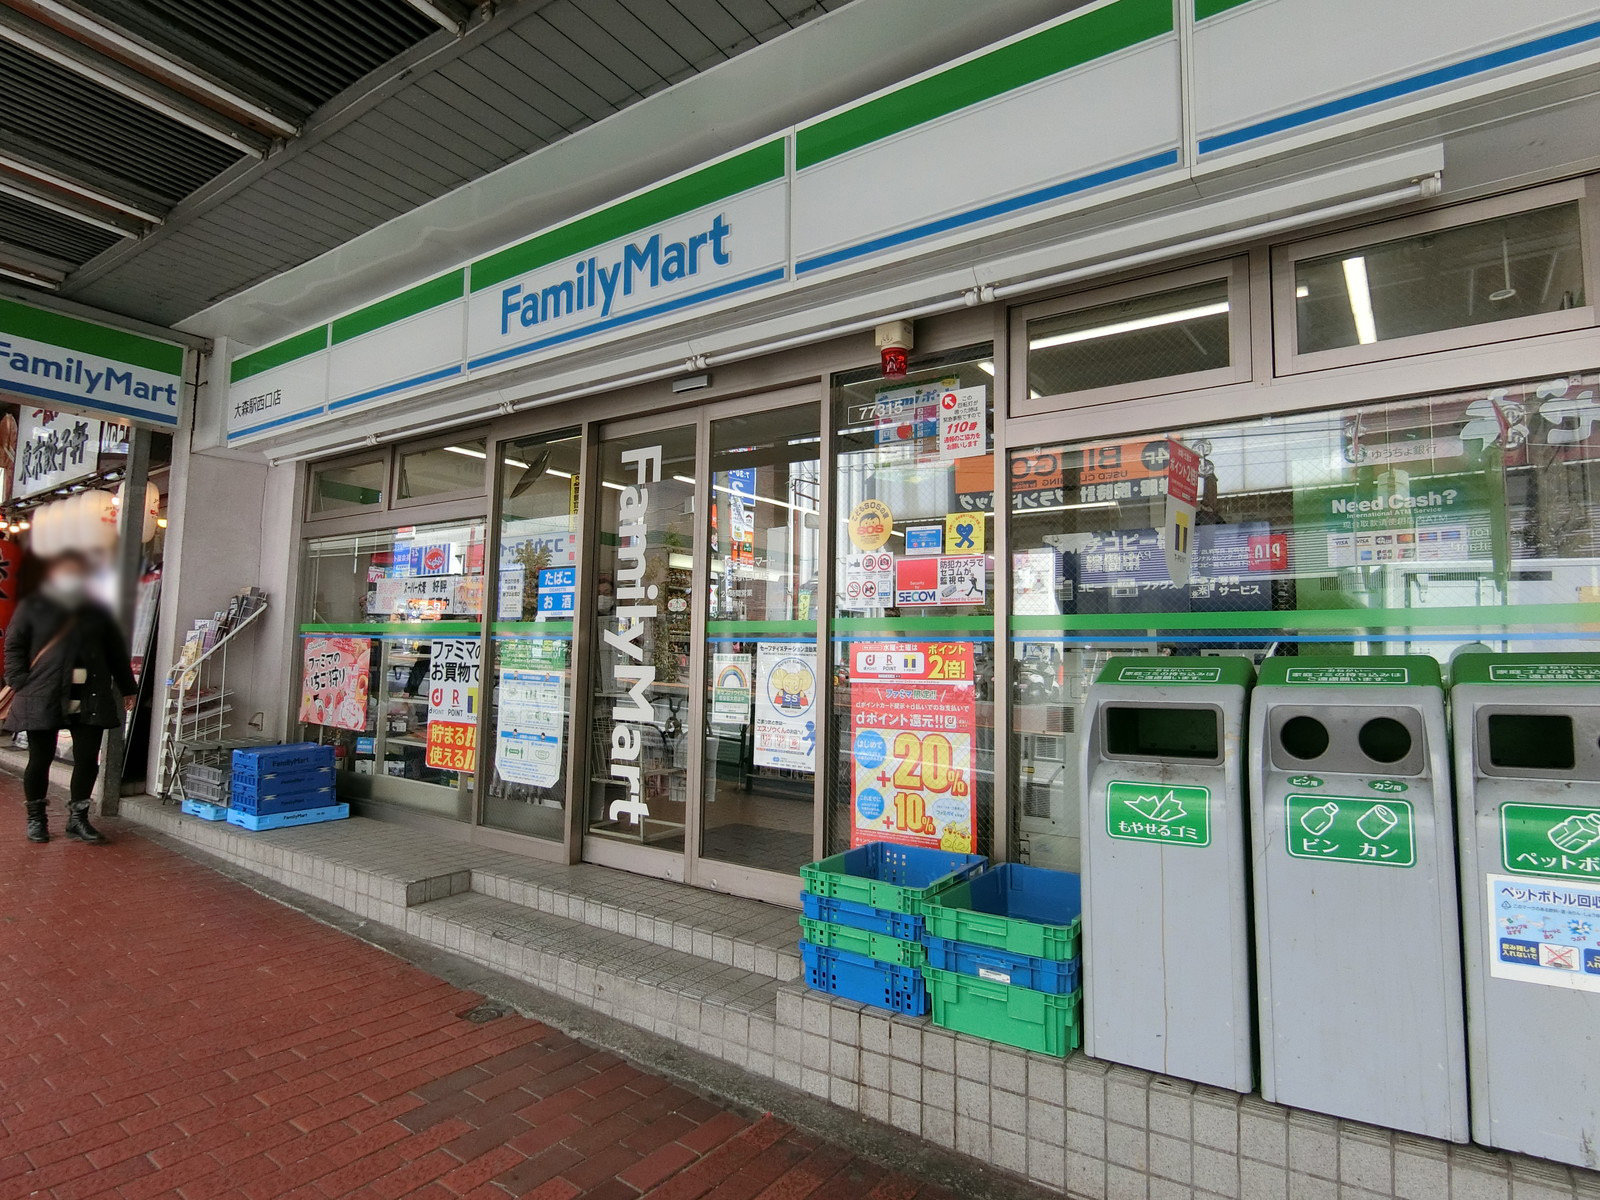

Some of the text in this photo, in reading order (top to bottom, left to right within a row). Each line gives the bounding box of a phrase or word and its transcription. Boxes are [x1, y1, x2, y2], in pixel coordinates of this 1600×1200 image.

[501, 213, 730, 335] FamilyMart
[234, 389, 281, 419] 大森駅西口店
[859, 400, 903, 420] 77315
[947, 421, 978, 435] 110番
[946, 441, 979, 451] お願いします
[1371, 443, 1437, 460] ゆうちょ銀行
[1332, 489, 1458, 514] Need Cash?
[1346, 506, 1442, 519] International ATM Service
[857, 524, 884, 535] SOS
[940, 558, 984, 570] 防犯カメラで
[544, 571, 572, 586] たばこ
[940, 568, 972, 577] セコムが
[432, 580, 448, 593] 好評
[940, 576, 966, 585] 監視中
[898, 591, 936, 603] SECOM
[1219, 585, 1262, 596] サービス
[543, 595, 572, 609] お酒
[603, 445, 662, 824] FamilyMart
[928, 644, 966, 655] ポイント
[308, 652, 341, 670] ファミマの
[928, 655, 966, 679] 2倍!
[304, 666, 346, 691] いちご狩り
[448, 709, 463, 717] POINT
[272, 758, 309, 767] FamilyMart
[1292, 776, 1319, 788] ビン用
[1373, 780, 1402, 792] カン用
[283, 813, 308, 821] FamilyMart
[1118, 820, 1198, 840] もやせるゴミ
[1302, 838, 1399, 858] ビン カン
[1502, 943, 1537, 954] 飲み残しを
[1502, 950, 1538, 960] 入れないで
